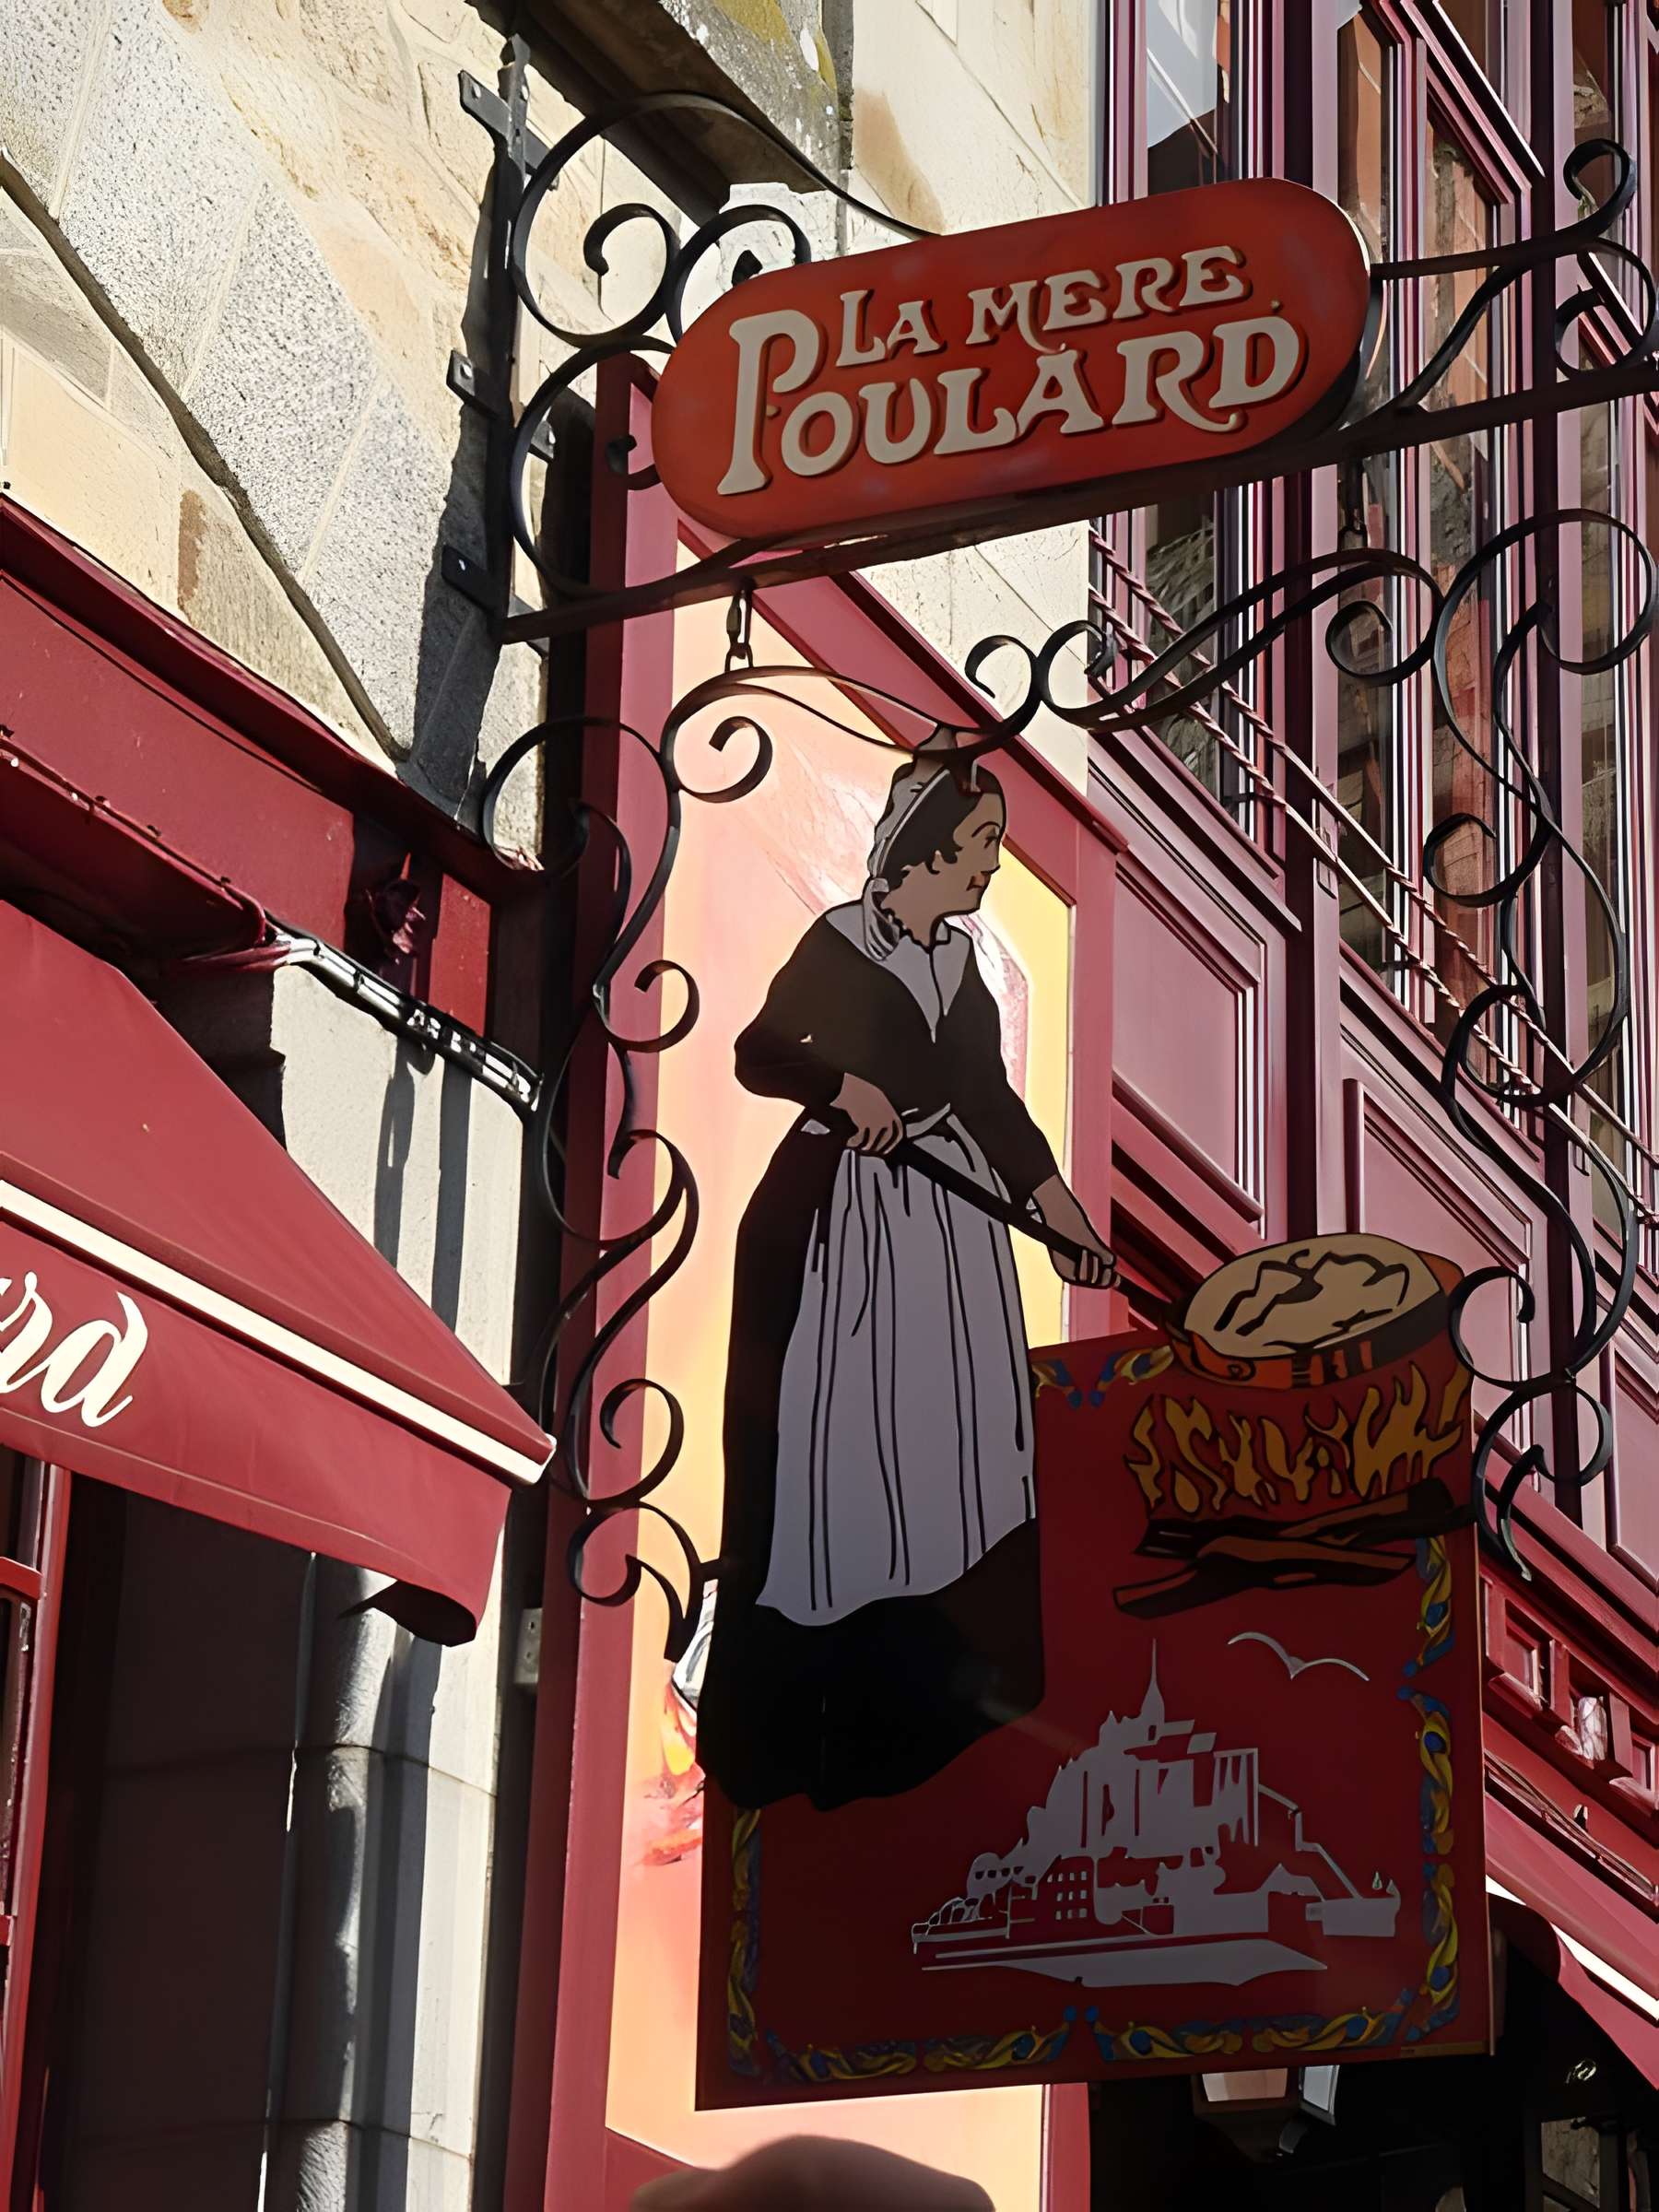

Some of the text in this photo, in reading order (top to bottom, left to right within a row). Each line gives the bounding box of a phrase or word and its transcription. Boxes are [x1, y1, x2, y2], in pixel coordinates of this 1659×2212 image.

[836, 245, 1248, 368] LA MERE
[717, 309, 1302, 495] POULARD
[0, 1271, 148, 1428] rd
